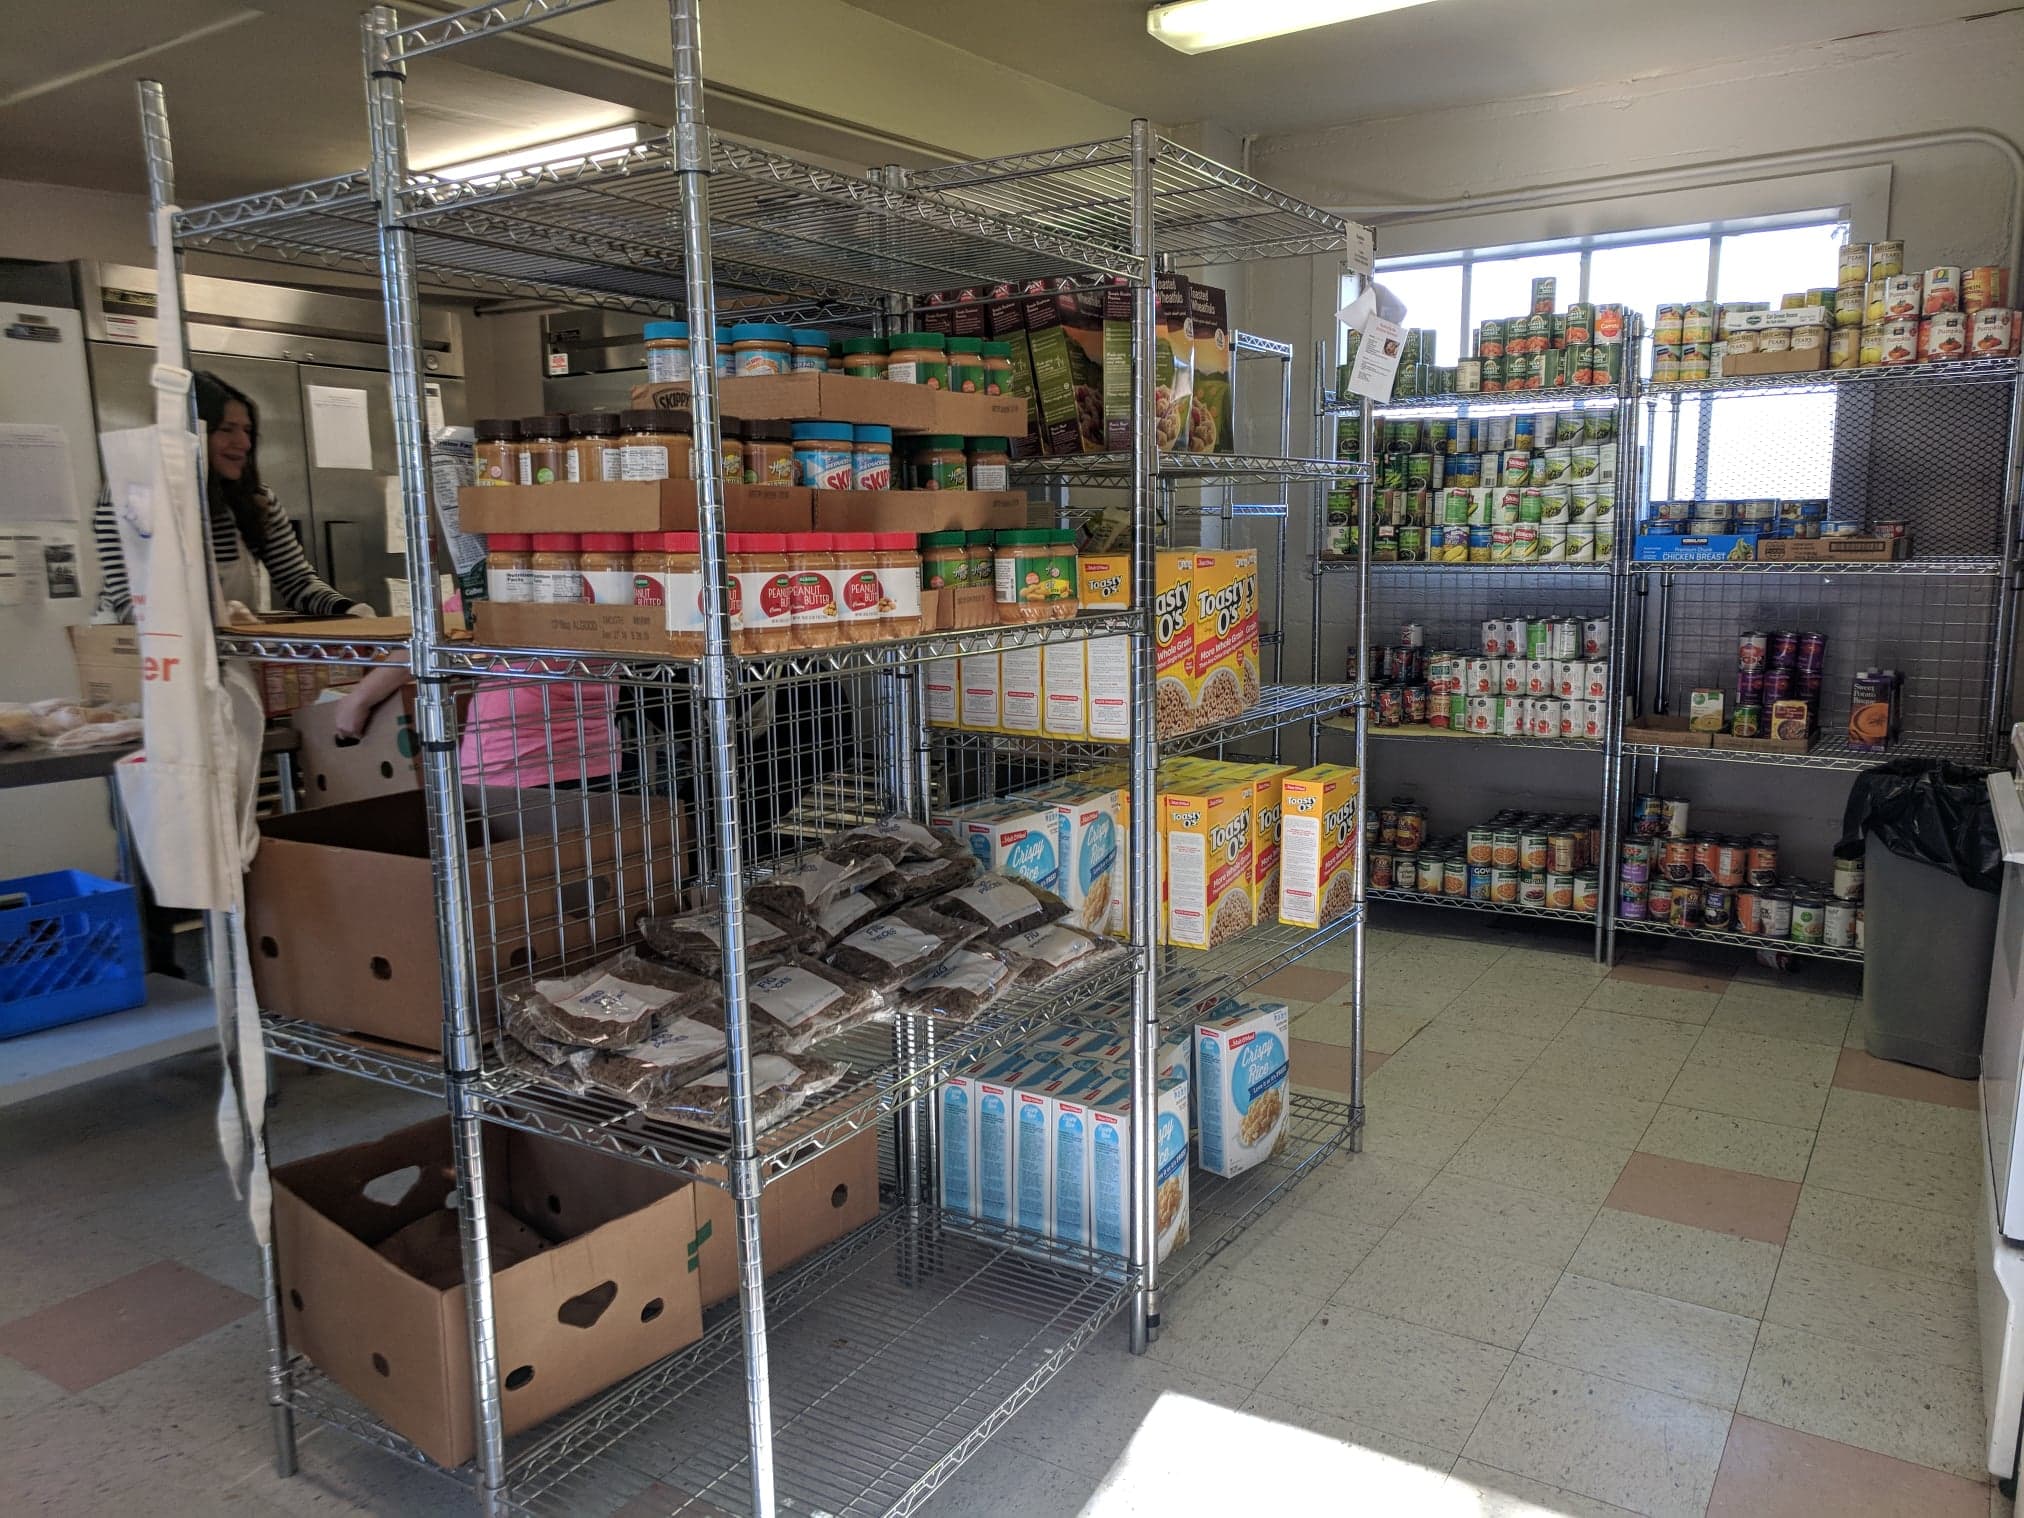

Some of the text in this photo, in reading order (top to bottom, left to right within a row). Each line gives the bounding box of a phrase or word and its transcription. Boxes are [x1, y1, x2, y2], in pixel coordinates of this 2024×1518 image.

[1662, 553, 1726, 561] CHICKEN BREAST
[790, 585, 820, 597] PEANUT
[1088, 575, 1123, 590] Toasty
[804, 594, 831, 606] BUTTER
[1156, 580, 1191, 616] asty
[1198, 578, 1246, 620] Toasty
[1157, 636, 1192, 661] Whole Grain
[1200, 648, 1214, 660] More
[1216, 639, 1231, 653] Whole
[1287, 796, 1317, 806] Toasty
[1172, 811, 1201, 822] Toasty
[1258, 803, 1282, 833] Toa
[1209, 806, 1251, 853] Toasty
[1012, 839, 1045, 868] Crispy
[1474, 867, 1489, 875] GOY
[757, 976, 777, 990] FIG
[1242, 1038, 1274, 1067] Crispy
[1248, 1062, 1269, 1085] Rice
